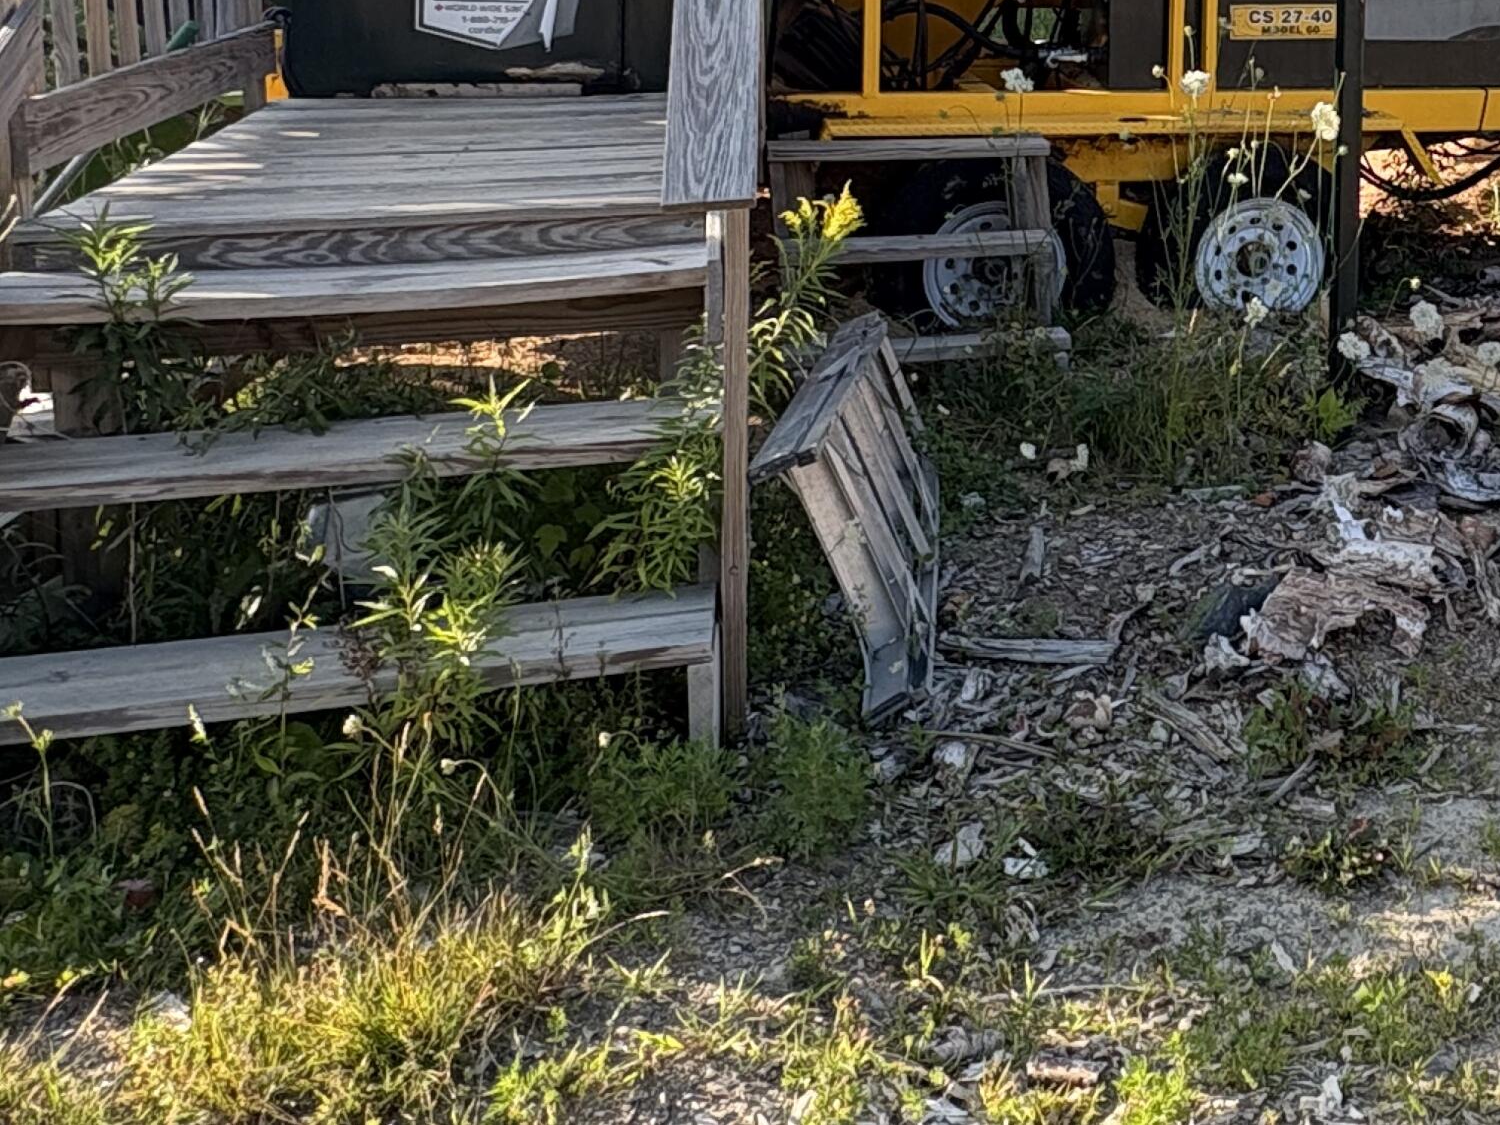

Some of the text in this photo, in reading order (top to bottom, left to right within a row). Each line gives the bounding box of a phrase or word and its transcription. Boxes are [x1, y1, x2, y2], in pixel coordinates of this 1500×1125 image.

[1249, 9, 1332, 24] CS 27-40
[1261, 25, 1302, 35] MODEL
